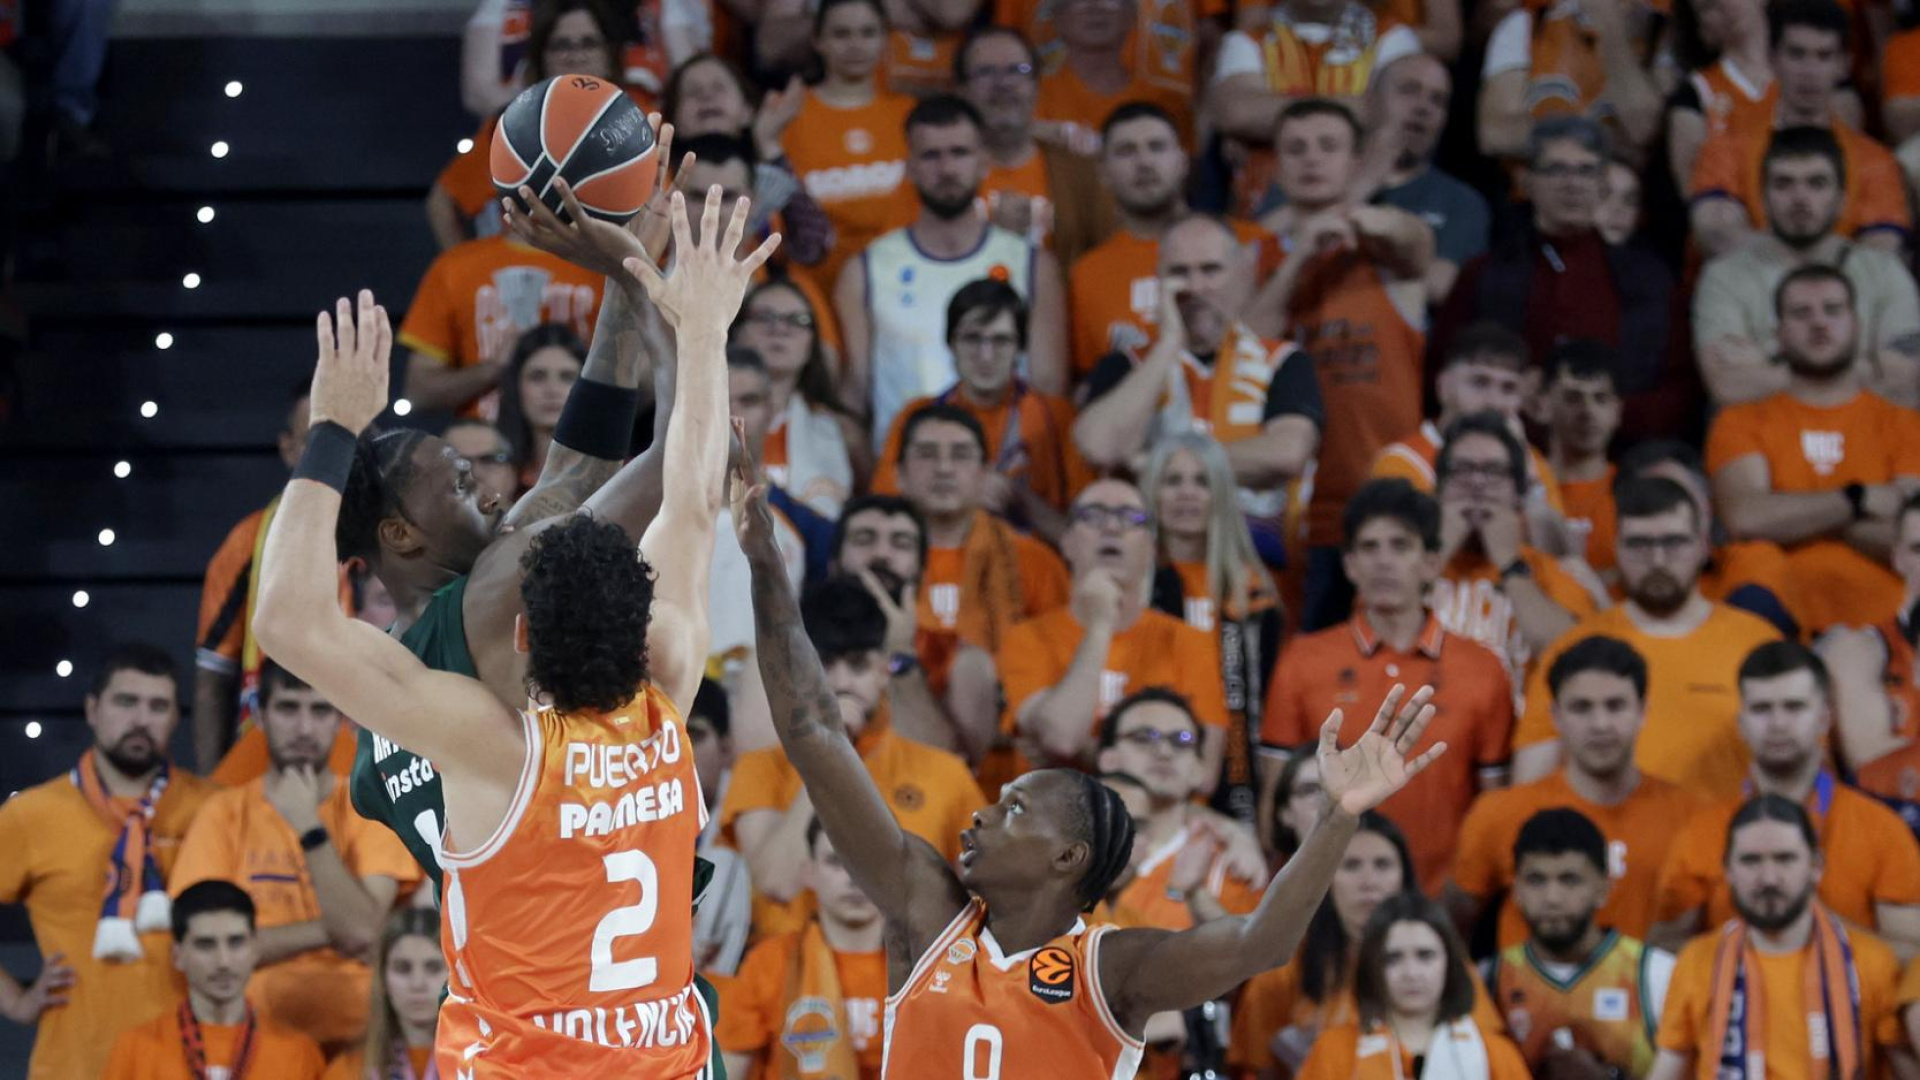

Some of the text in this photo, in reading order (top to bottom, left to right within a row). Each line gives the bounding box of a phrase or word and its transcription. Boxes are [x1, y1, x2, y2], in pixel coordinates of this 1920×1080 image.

[565, 719, 680, 788] PUERTO
[560, 777, 683, 838] PAMESA
[589, 848, 659, 992] 2
[963, 1023, 1003, 1080] 0
